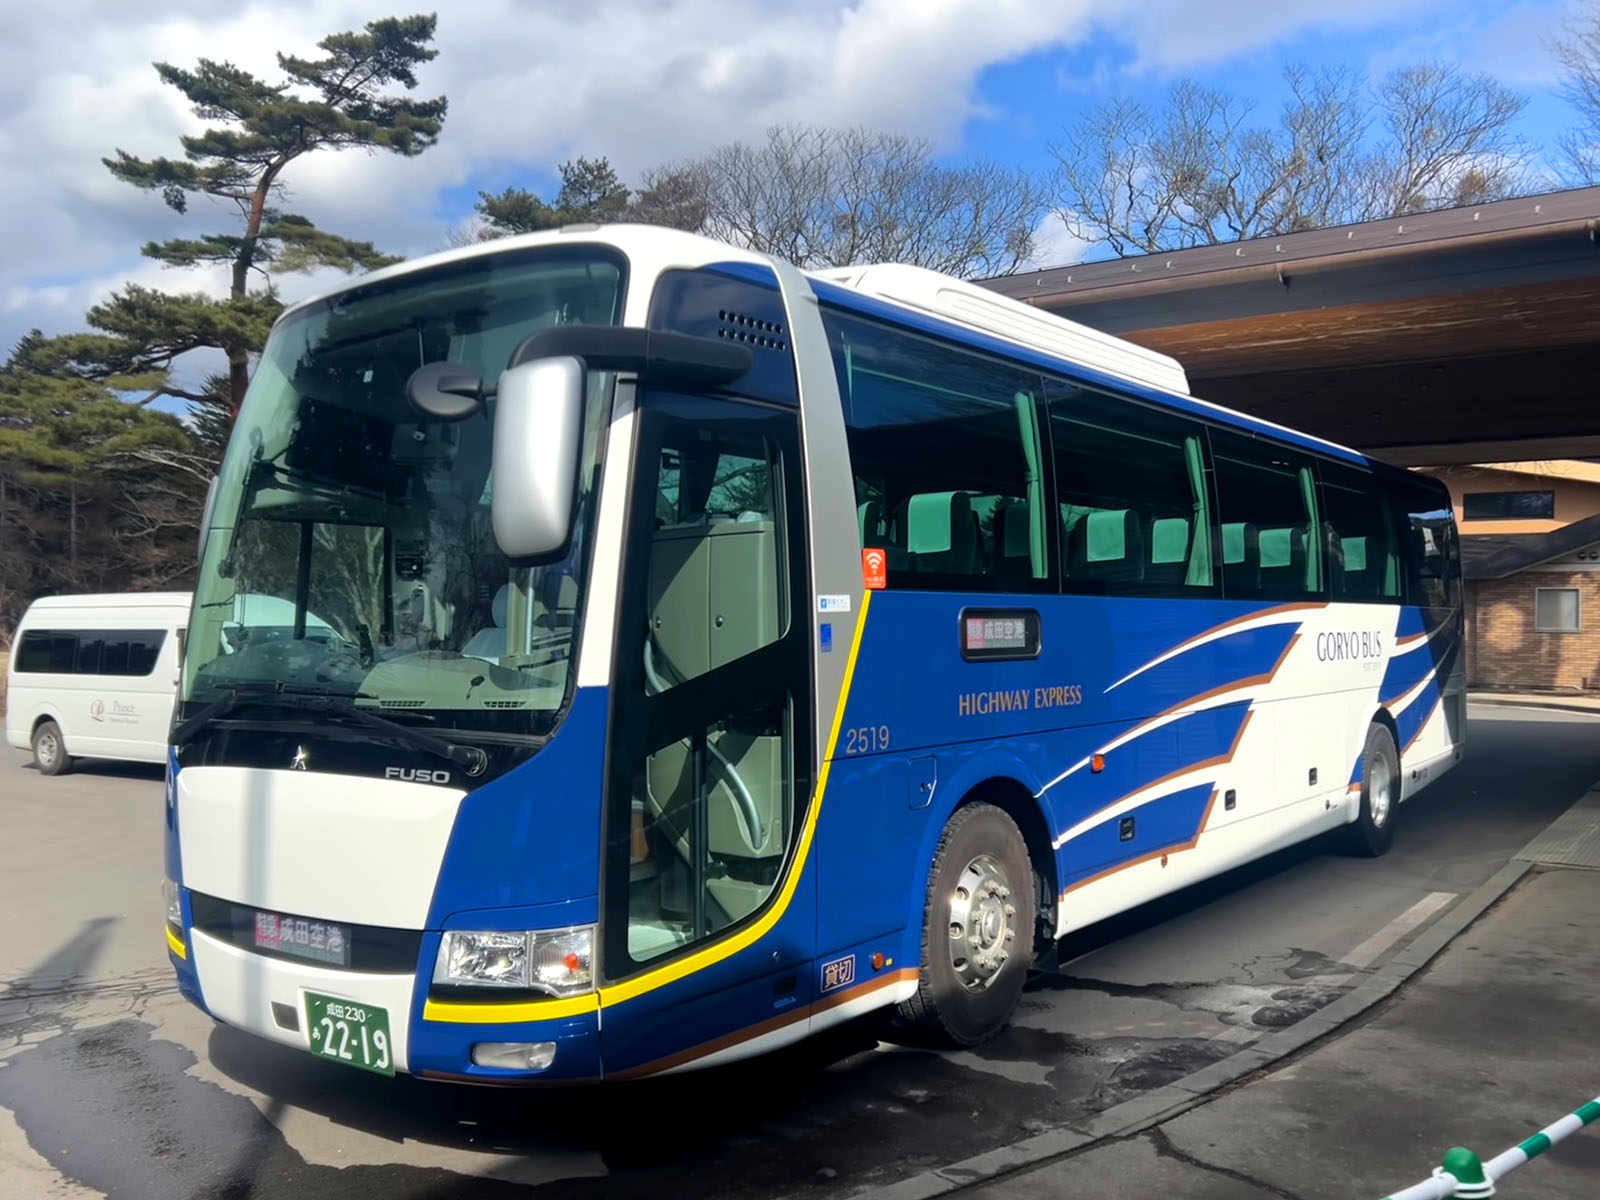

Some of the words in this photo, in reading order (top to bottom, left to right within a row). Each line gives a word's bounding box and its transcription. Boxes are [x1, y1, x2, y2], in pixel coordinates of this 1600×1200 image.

[1316, 631, 1360, 662] GORYO
[1362, 630, 1382, 658] BUS
[959, 688, 1030, 716] HIGHWAY
[1034, 684, 1082, 709] EXPRESS
[846, 725, 890, 753] 2519
[385, 766, 450, 784] FUSO
[279, 917, 344, 953] 成田空港
[824, 959, 852, 989] 貸切
[320, 1017, 389, 1069] 22-19
